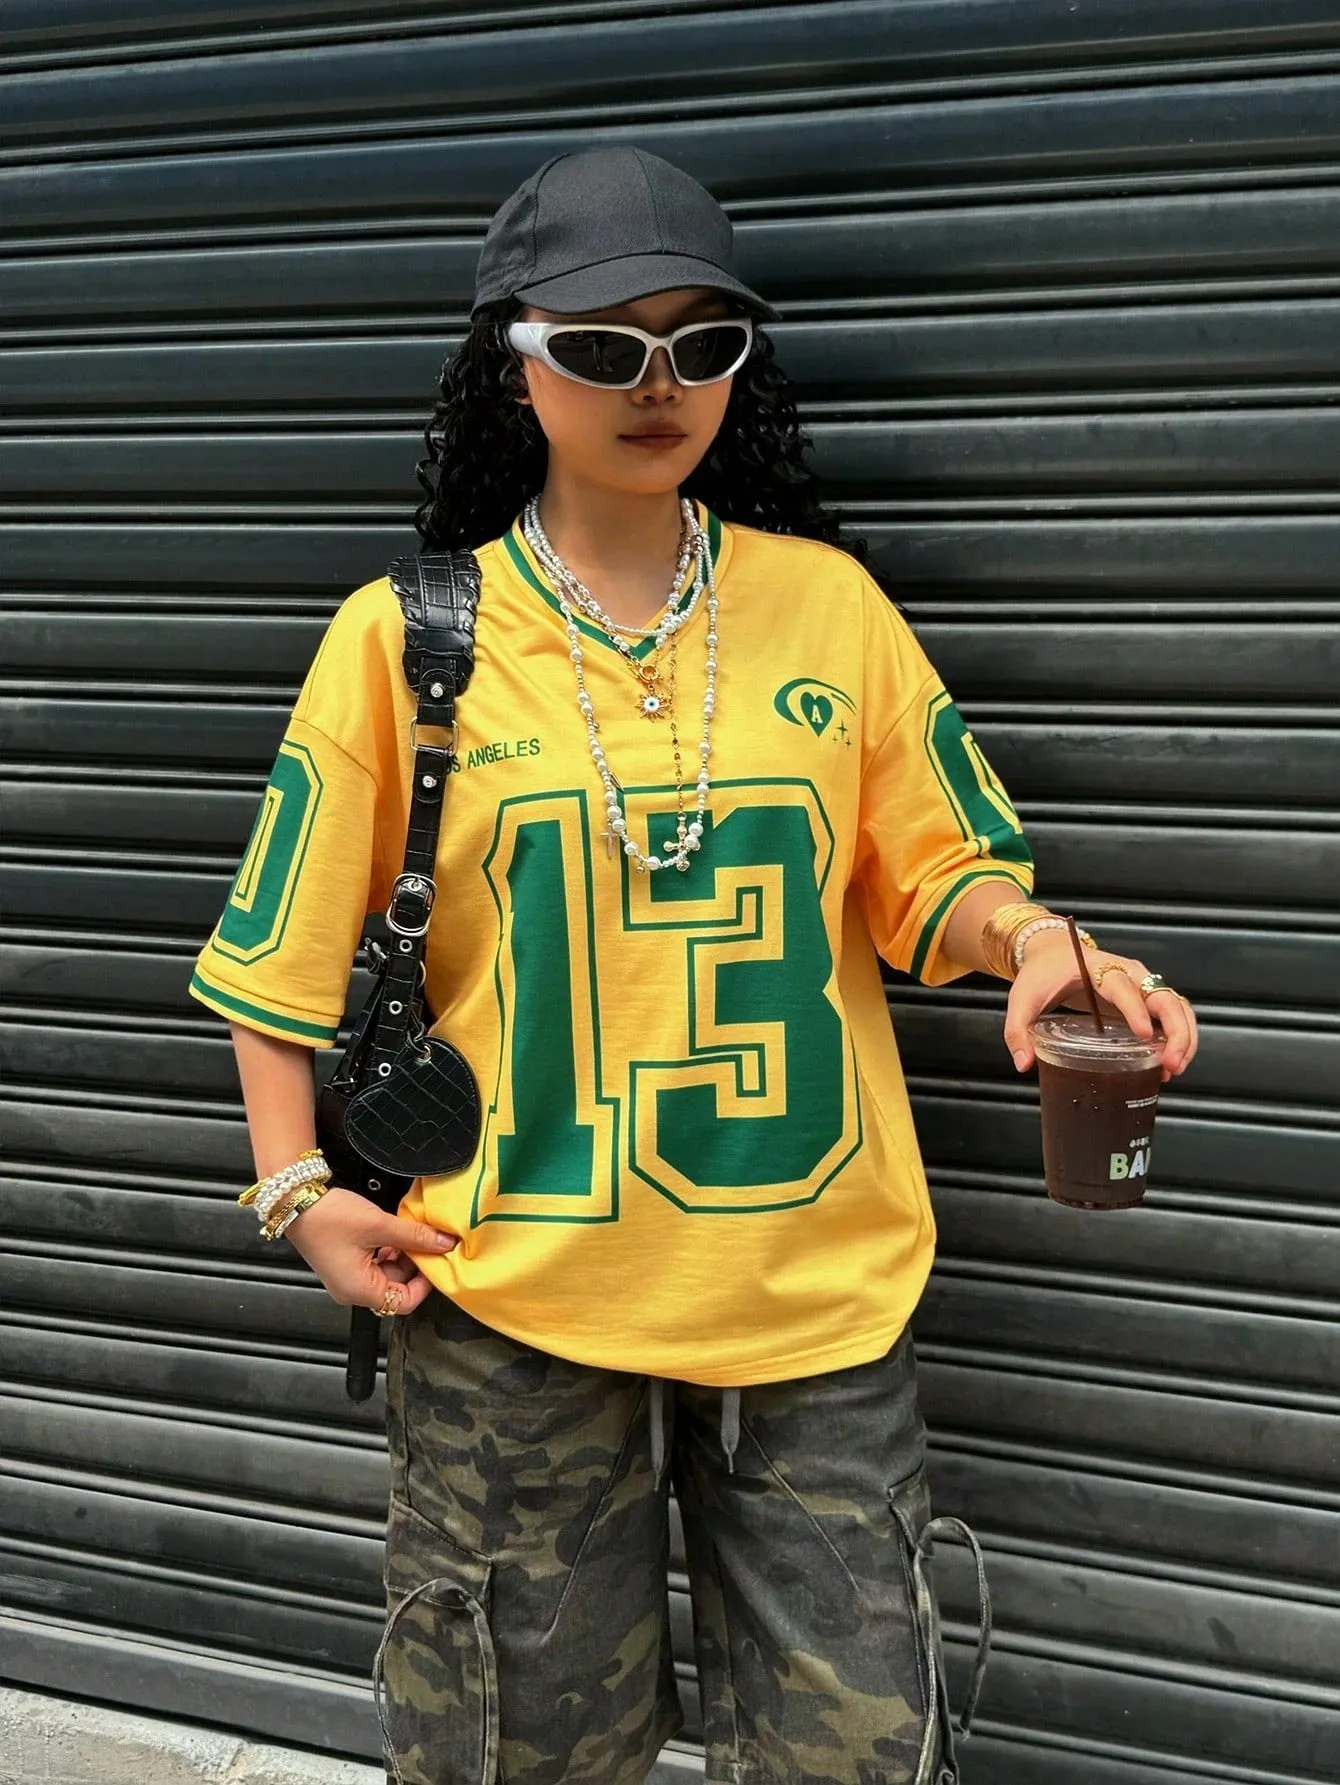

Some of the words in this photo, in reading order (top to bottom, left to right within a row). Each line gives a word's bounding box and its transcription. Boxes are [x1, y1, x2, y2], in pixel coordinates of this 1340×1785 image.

[811, 704, 824, 723] A
[467, 738, 540, 769] ANGELES
[472, 777, 862, 1223] 13
